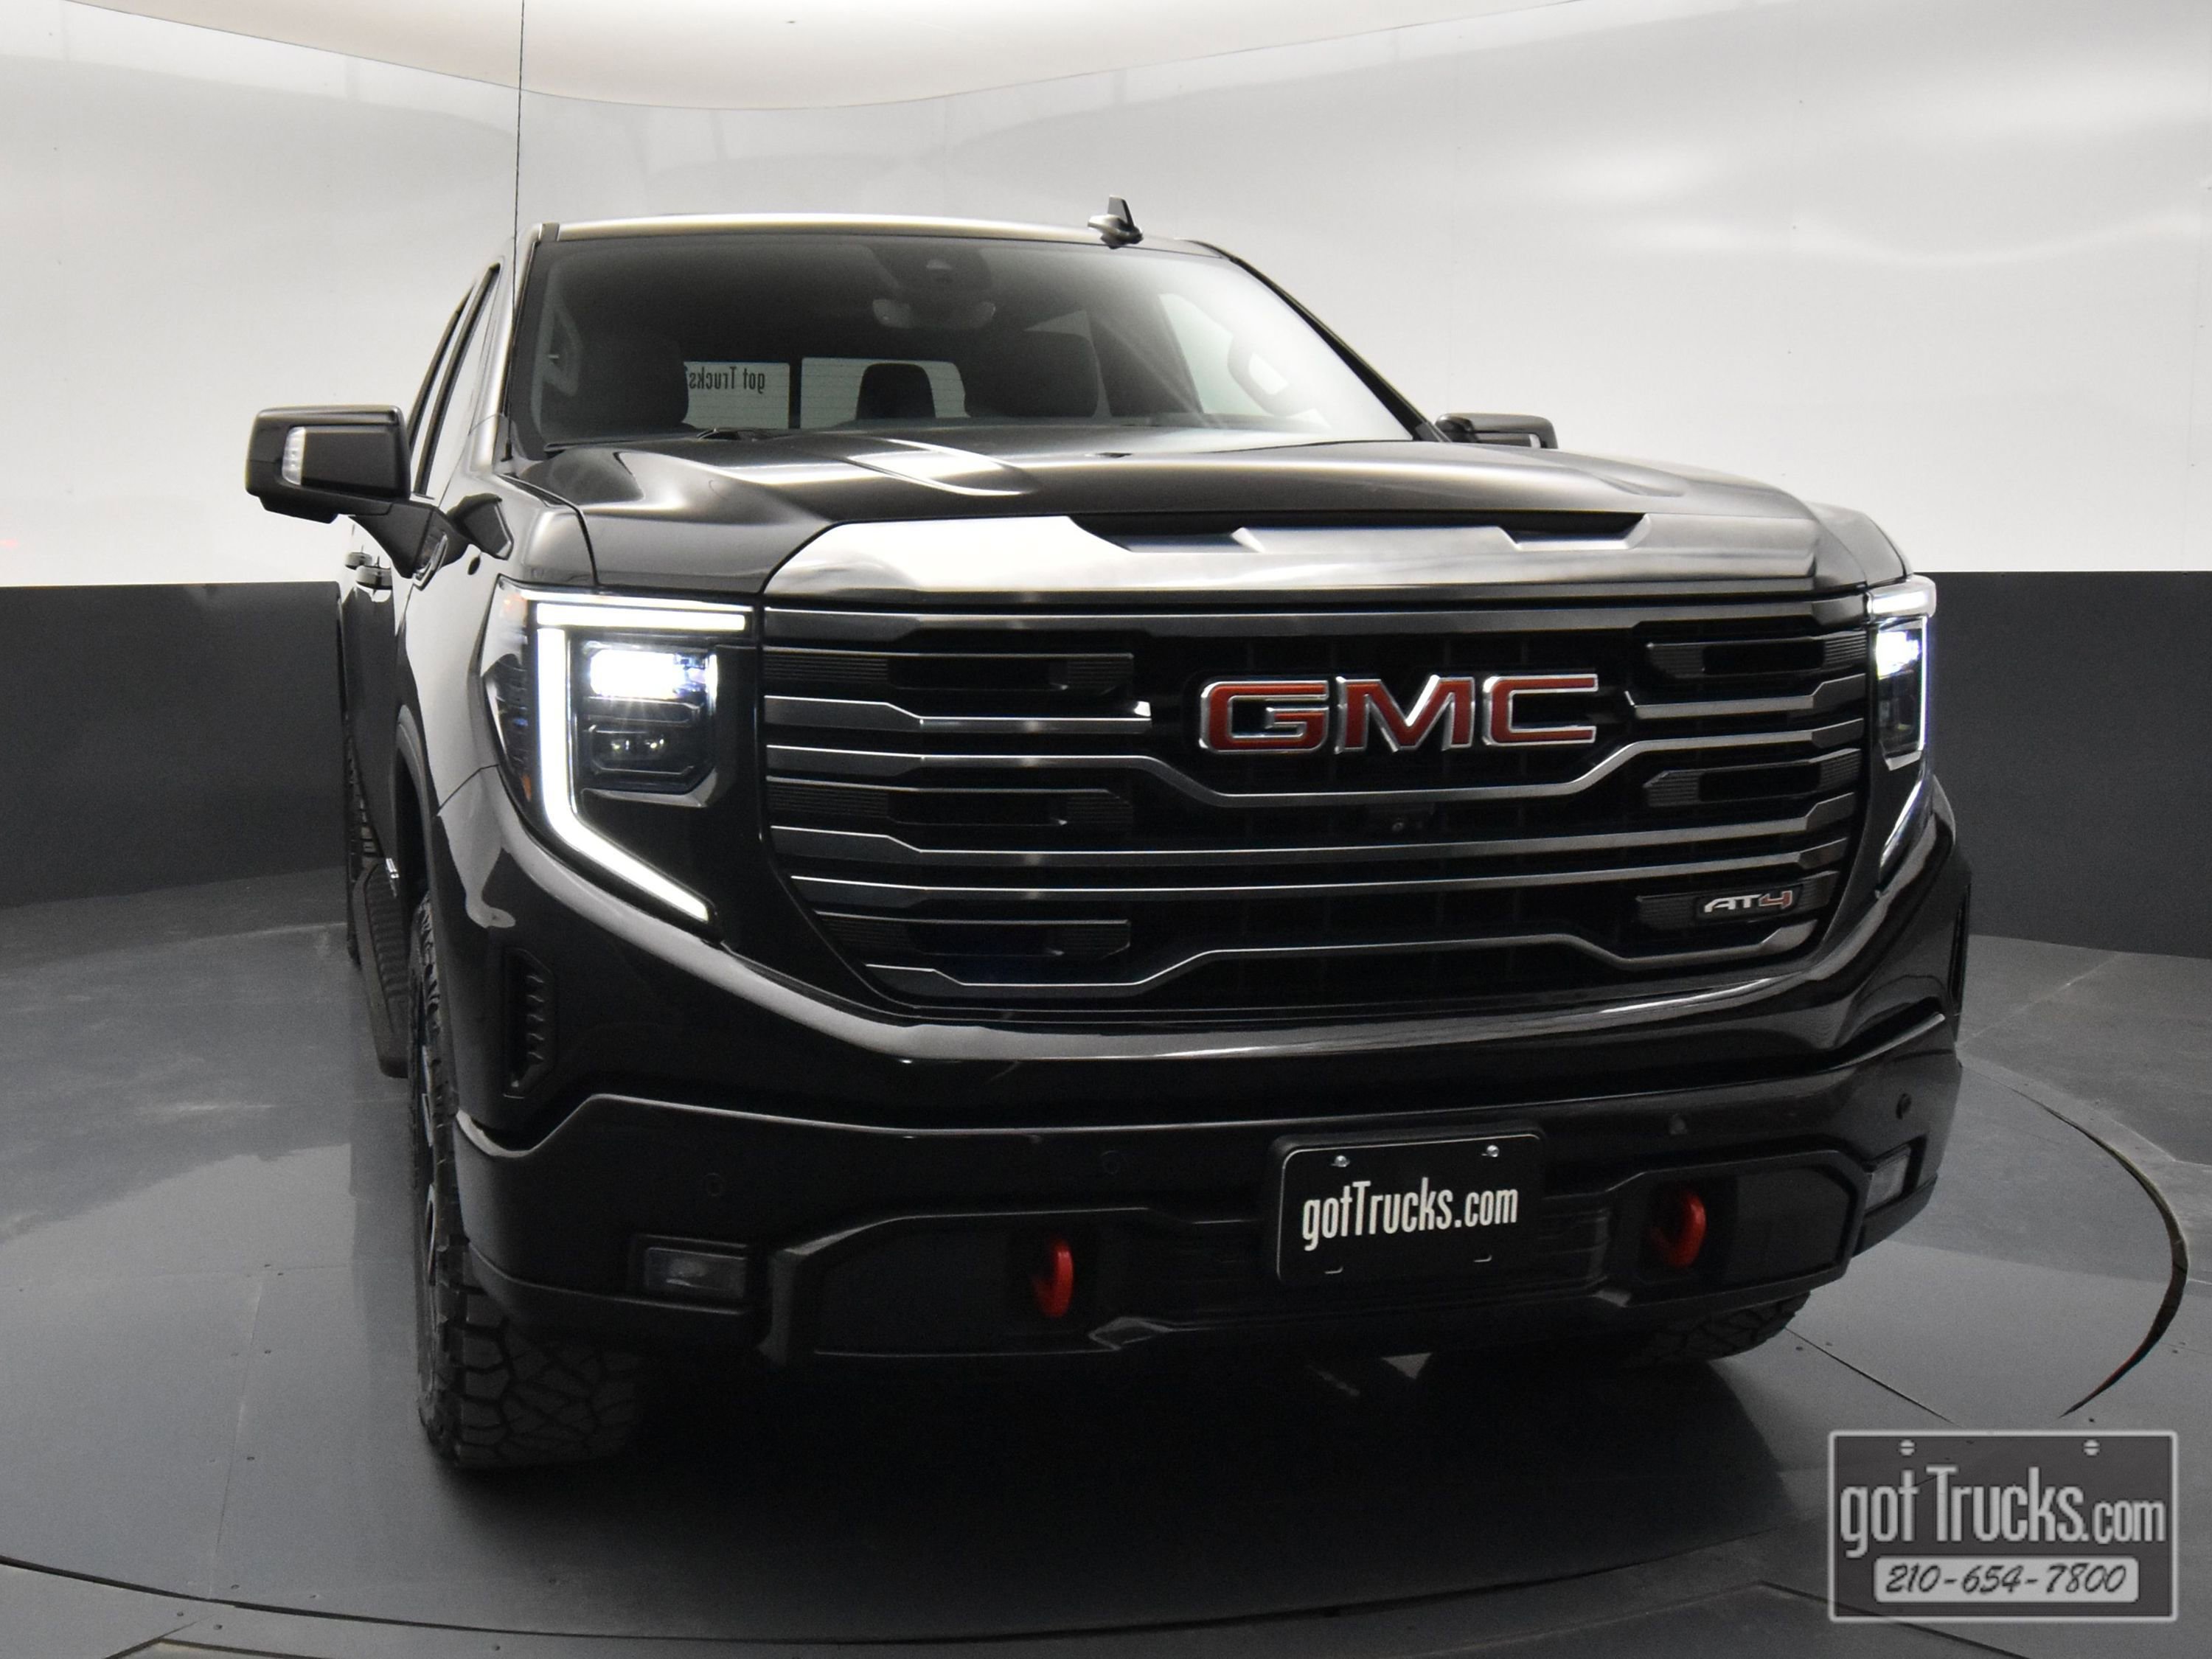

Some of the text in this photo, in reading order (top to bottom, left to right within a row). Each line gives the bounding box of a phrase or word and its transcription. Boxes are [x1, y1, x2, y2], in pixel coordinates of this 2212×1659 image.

[1199, 673, 1599, 754] GMC
[1704, 890, 1792, 913] AT4
[1302, 1177, 1518, 1251] gotTrucks.com
